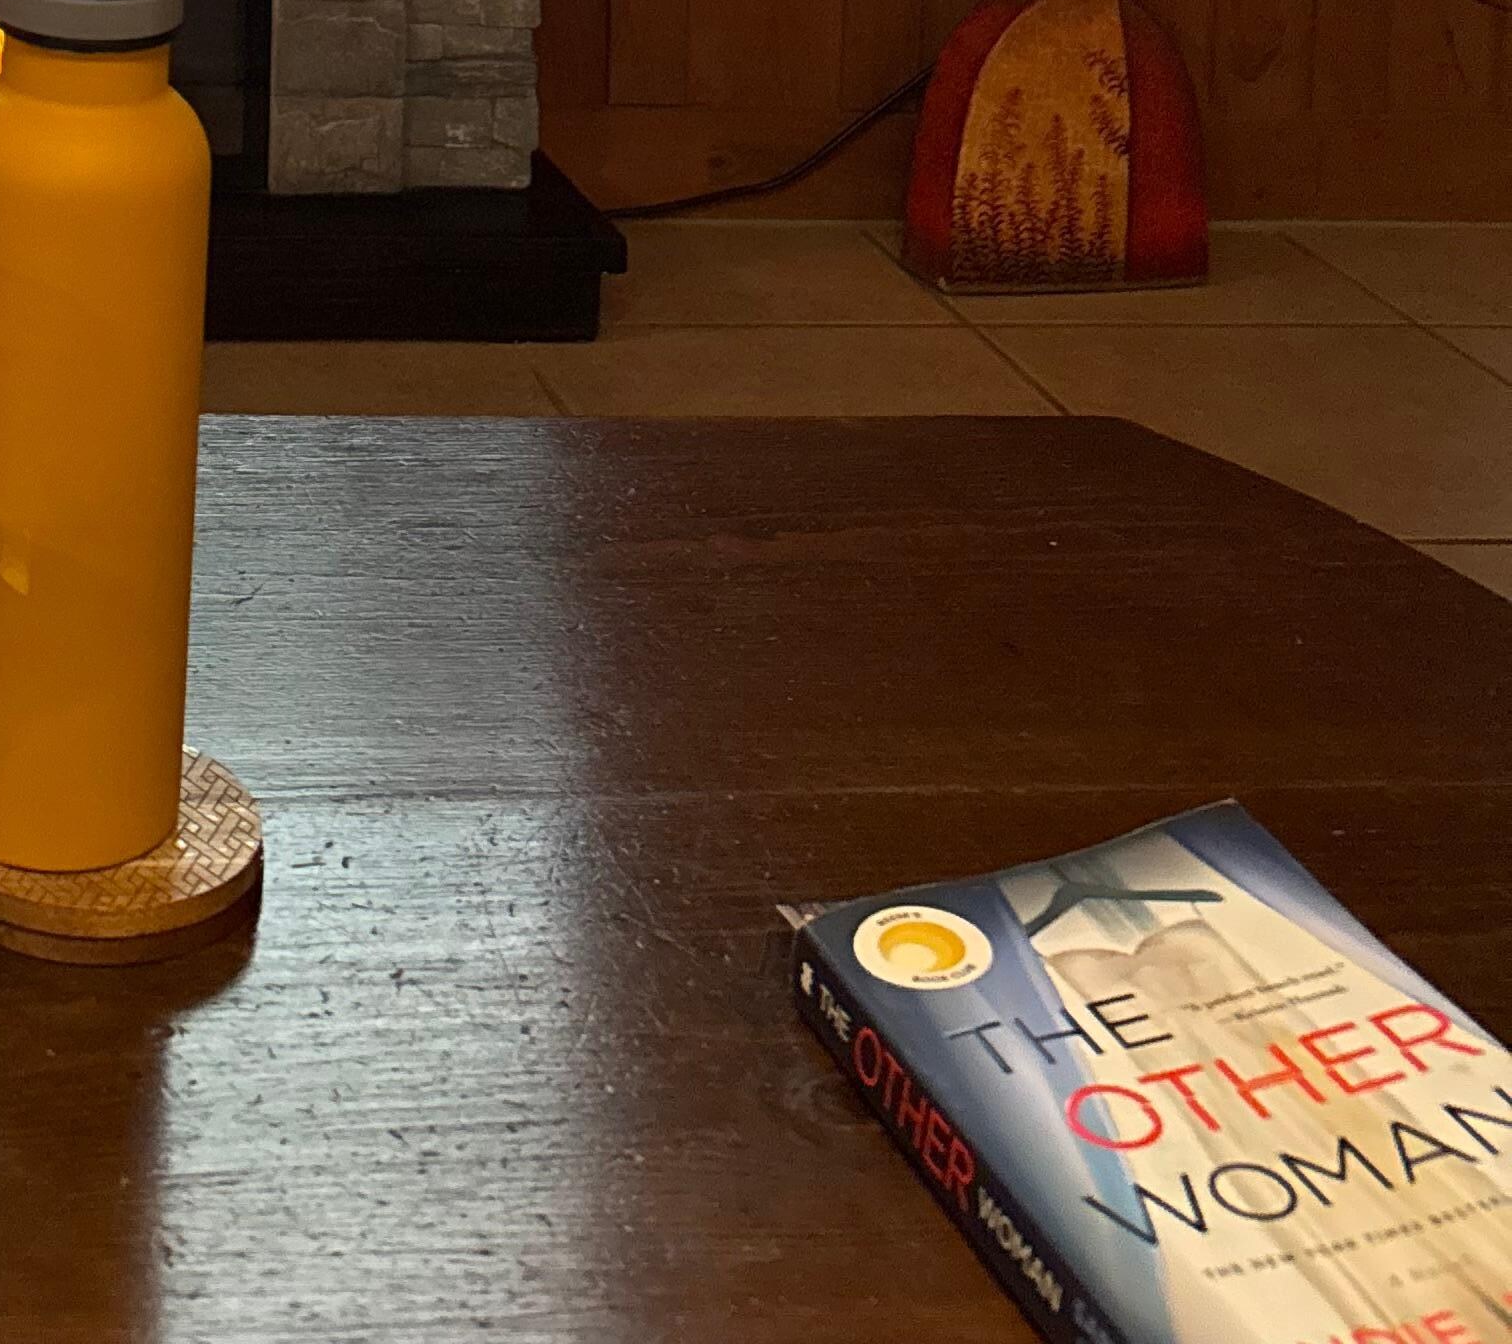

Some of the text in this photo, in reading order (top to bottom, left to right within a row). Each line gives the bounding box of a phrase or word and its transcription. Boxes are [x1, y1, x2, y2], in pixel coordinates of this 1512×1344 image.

[947, 992, 1174, 1074] THE
[1065, 1003, 1486, 1151] OTHER
[854, 1025, 976, 1212] OTHER
[1083, 1085, 1512, 1246] WOMAN
